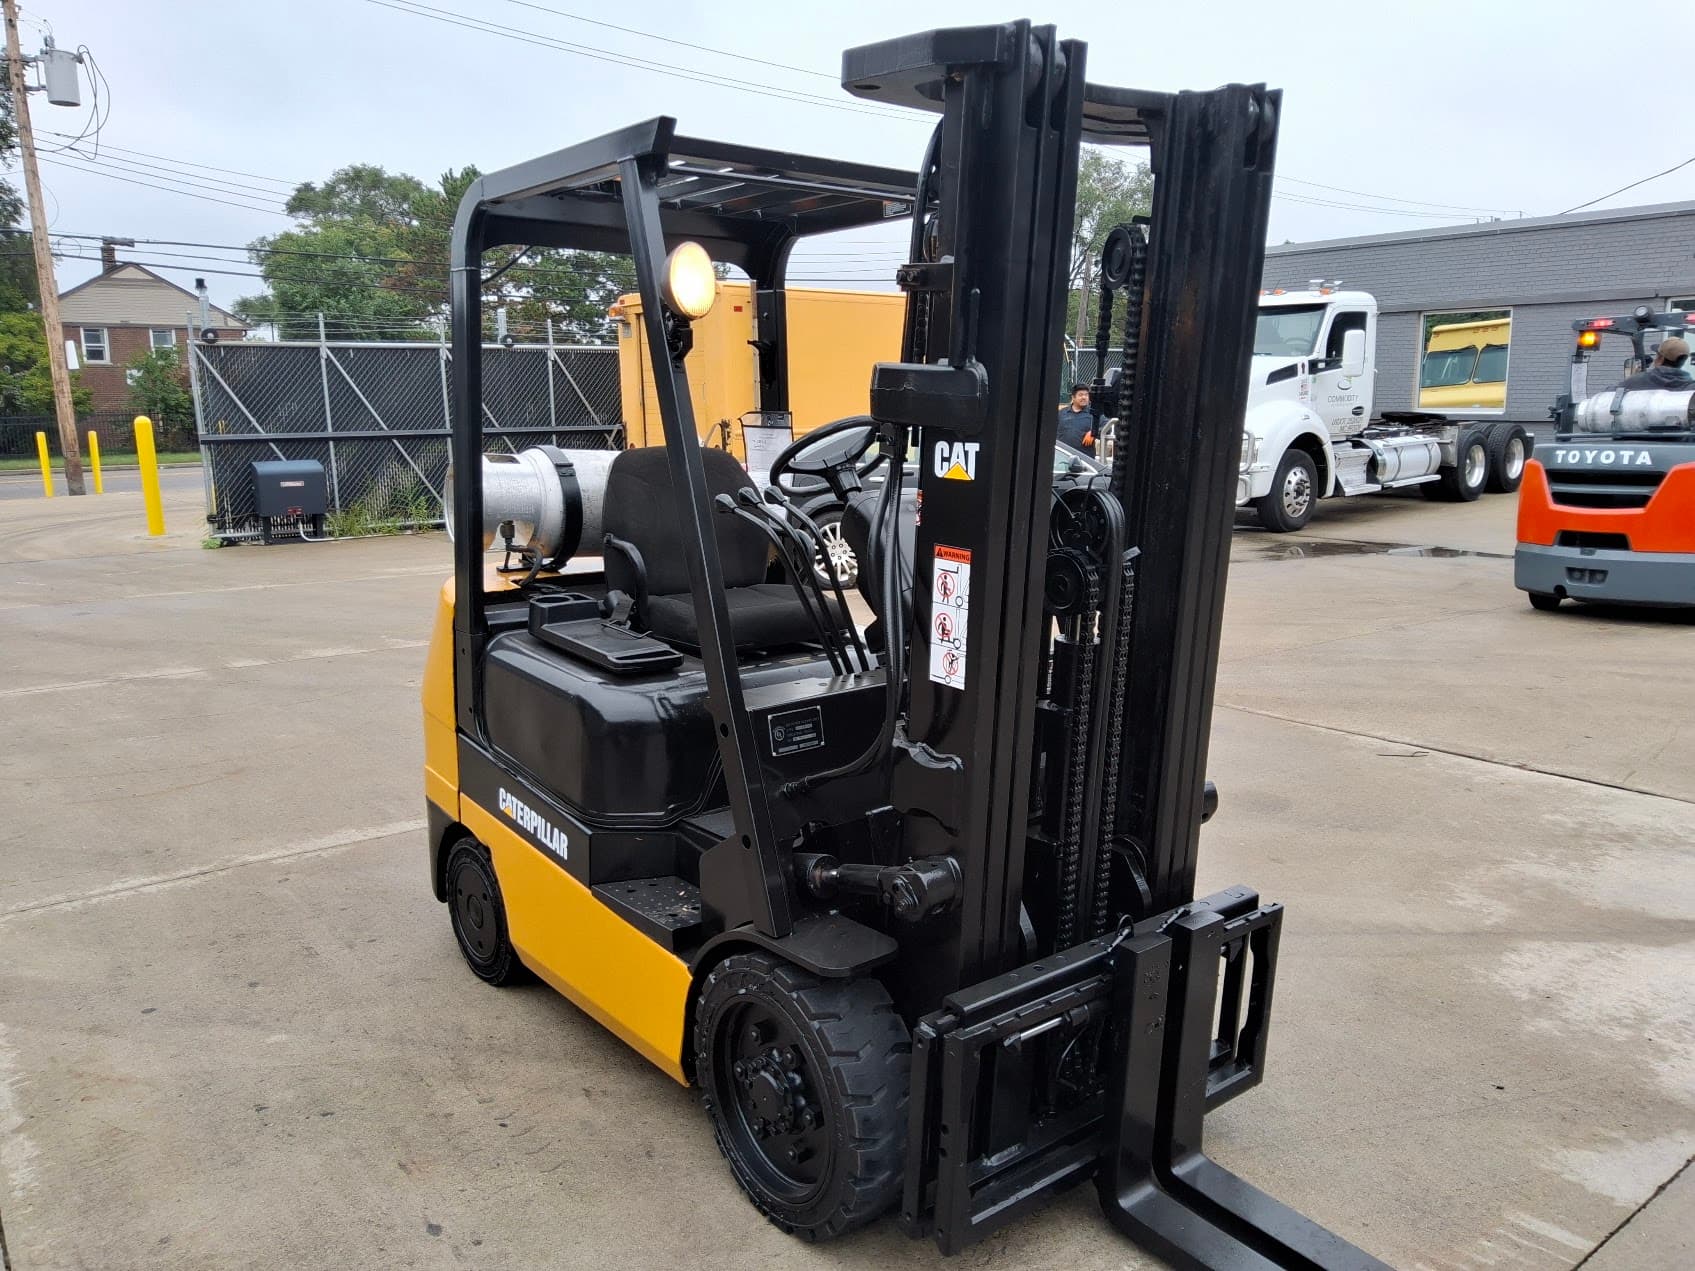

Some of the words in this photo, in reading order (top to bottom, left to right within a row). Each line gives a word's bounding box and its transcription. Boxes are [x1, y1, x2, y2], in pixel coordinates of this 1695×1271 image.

[934, 441, 980, 480] CAT
[1555, 450, 1652, 465] TOYOTA
[943, 551, 970, 561] WARNING
[499, 787, 568, 860] CATERPILLAR
